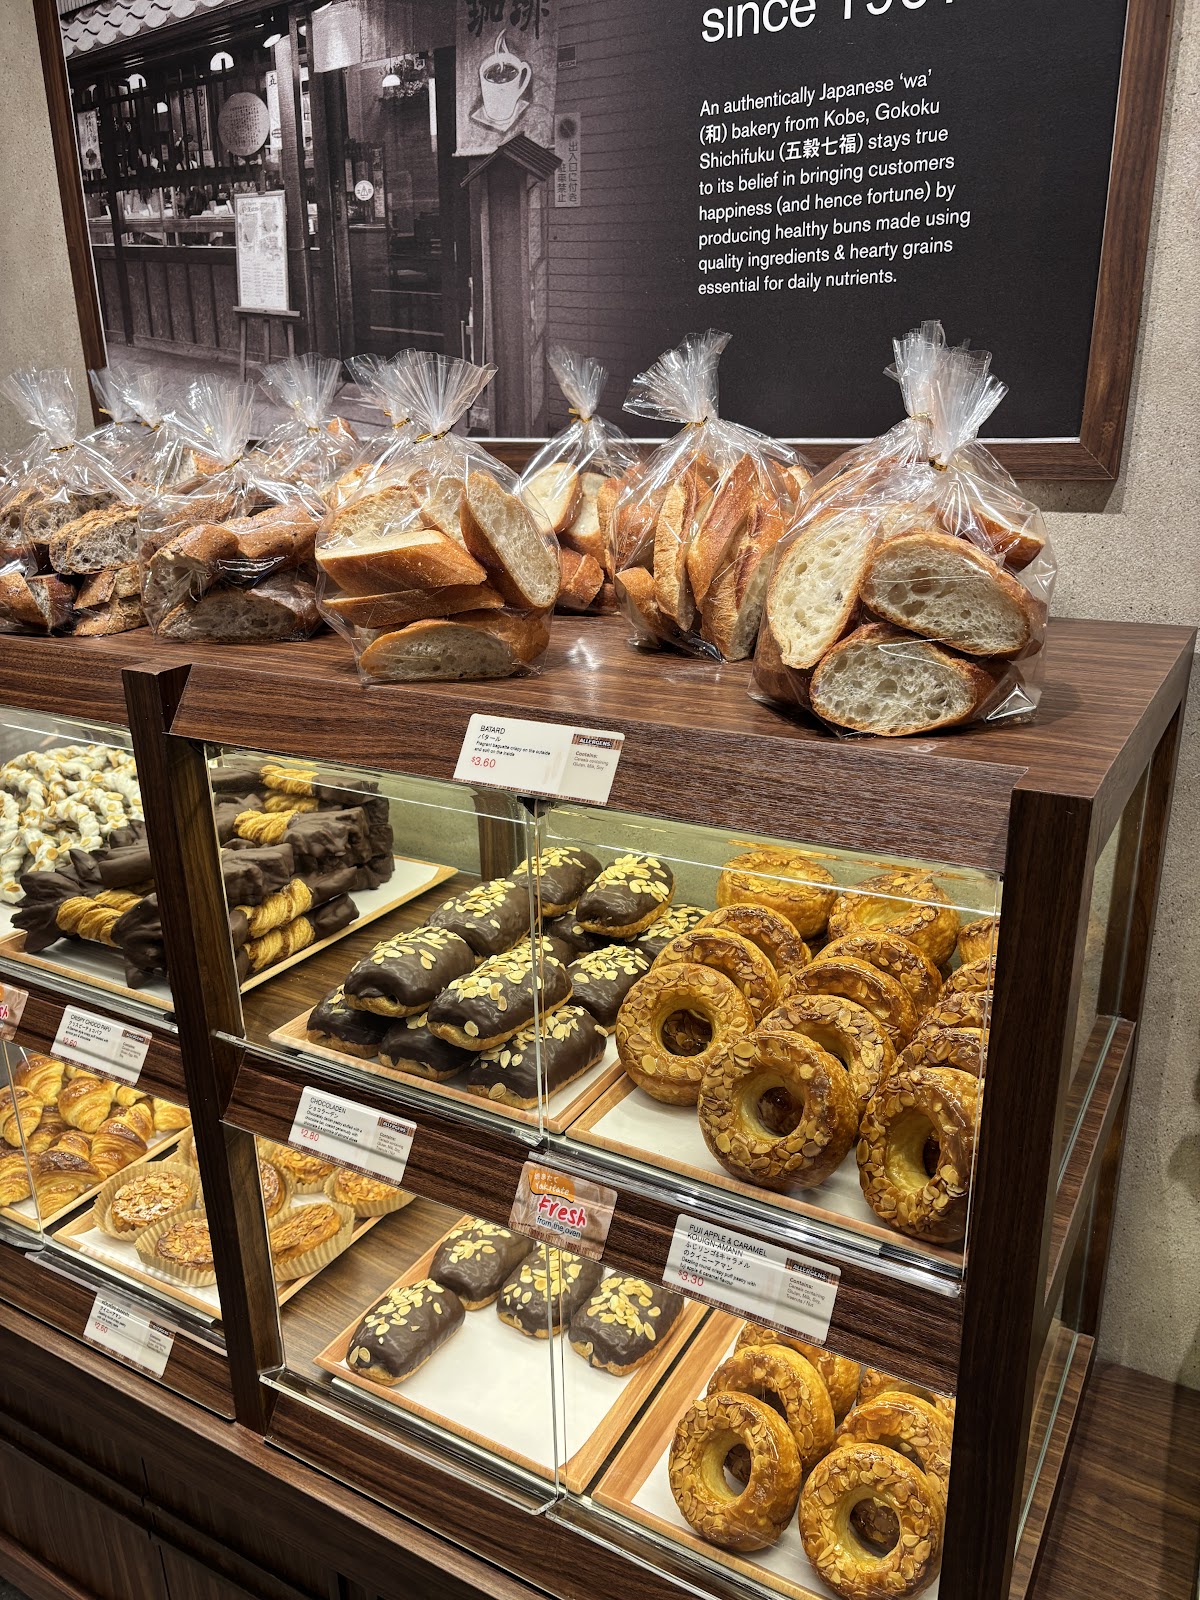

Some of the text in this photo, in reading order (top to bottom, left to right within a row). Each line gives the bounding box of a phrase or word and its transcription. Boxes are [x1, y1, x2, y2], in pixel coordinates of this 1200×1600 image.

[702, 0, 816, 42] since
[700, 100, 719, 116] An
[724, 86, 815, 113] authentically
[819, 78, 893, 102] Japanese
[700, 98, 940, 145] (和) bakery from Kobe, Gokoku
[700, 146, 774, 169] Shichifuku
[868, 130, 910, 152] stays
[916, 127, 948, 144] true
[699, 155, 955, 195] to its belief in bringing customers
[700, 181, 956, 225] happiness (and hence fortune) by
[699, 209, 971, 249] producing healthy buns made using
[699, 238, 953, 273] quality ingredients & hearty grains
[699, 269, 897, 295] essential for daily nutrients.
[480, 725, 505, 734] BATARD
[471, 756, 495, 768] $3.60
[301, 1128, 319, 1141] $2.80
[537, 1195, 586, 1226] Fresh
[536, 1216, 581, 1238] from the oven
[689, 1224, 703, 1234] FUJI
[703, 1230, 726, 1242] APPLE
[733, 1239, 766, 1257] CARAMEL
[687, 1231, 743, 1256] KOUIGN-AMANN
[678, 1268, 704, 1286] $3.30
[789, 1277, 813, 1289] Contains:
